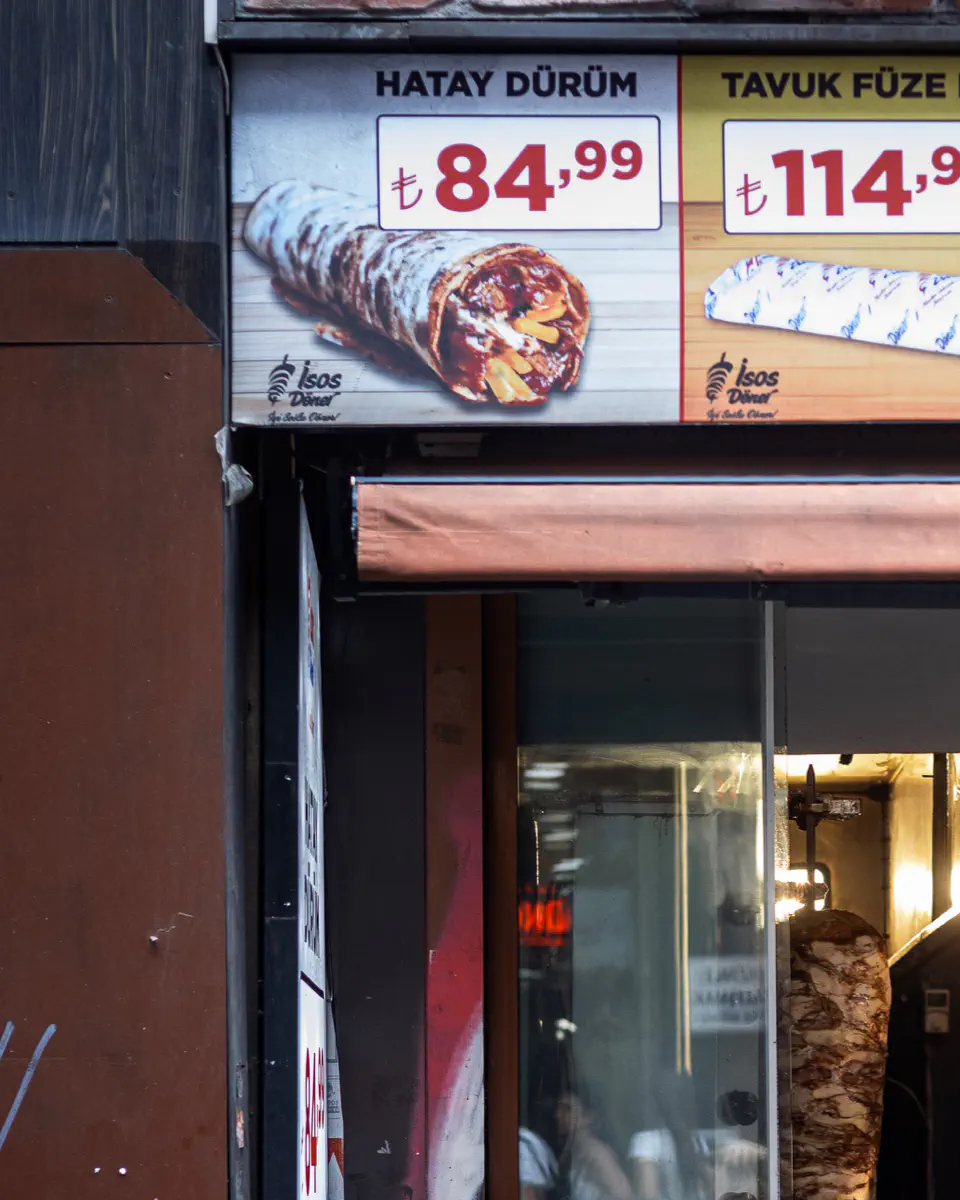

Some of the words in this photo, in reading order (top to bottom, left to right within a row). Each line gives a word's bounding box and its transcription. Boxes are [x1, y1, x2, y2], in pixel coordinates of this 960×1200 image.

[376, 71, 493, 97] HATAY
[506, 65, 637, 97] DÜRÜM
[722, 71, 841, 99] TAVUK
[852, 67, 950, 98] FÜZE
[298, 360, 342, 389] İsos
[736, 358, 779, 387] İsos
[289, 391, 341, 407] Döner
[727, 388, 778, 404] Döner
